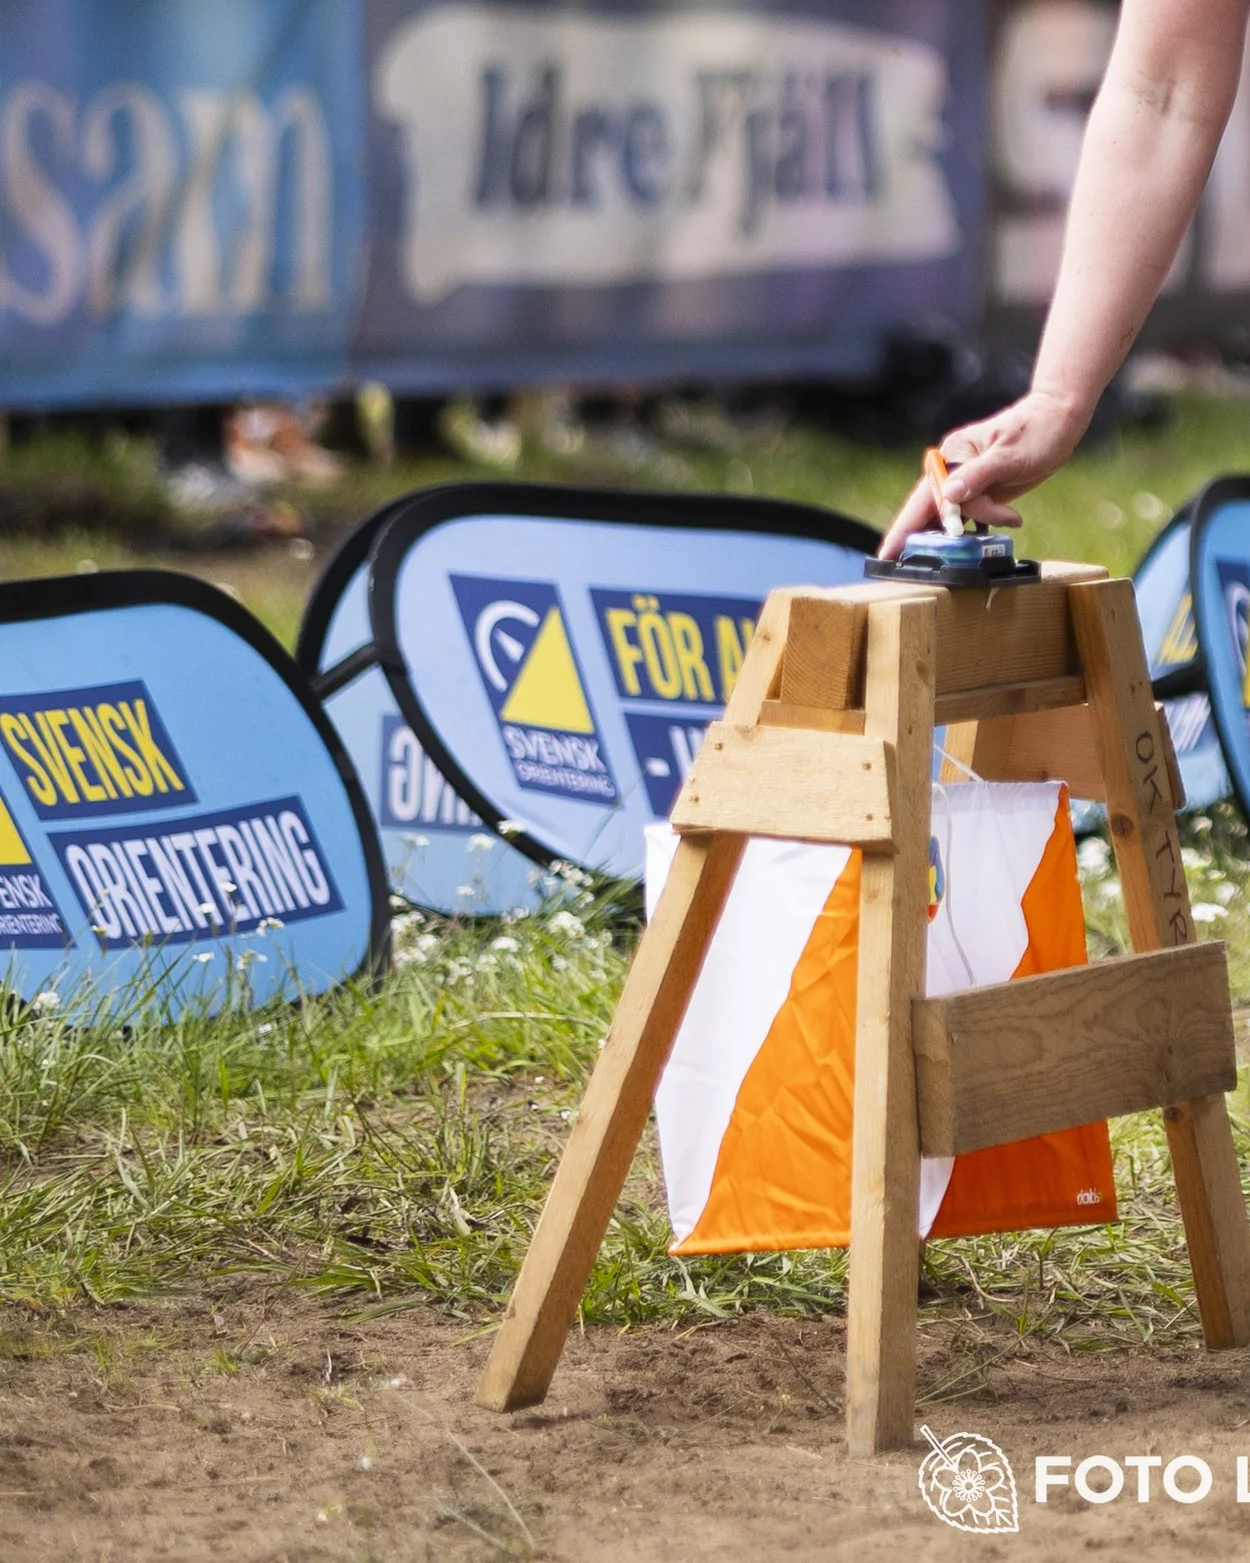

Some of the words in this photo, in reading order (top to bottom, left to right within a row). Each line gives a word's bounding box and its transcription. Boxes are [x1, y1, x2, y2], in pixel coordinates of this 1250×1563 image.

[474, 65, 666, 210] Idre
[606, 595, 715, 702] FÖR
[0, 698, 184, 806] SVENSK
[503, 725, 607, 773] SVENSK
[1135, 730, 1163, 814] OK
[65, 830, 331, 940] ORIENTERING
